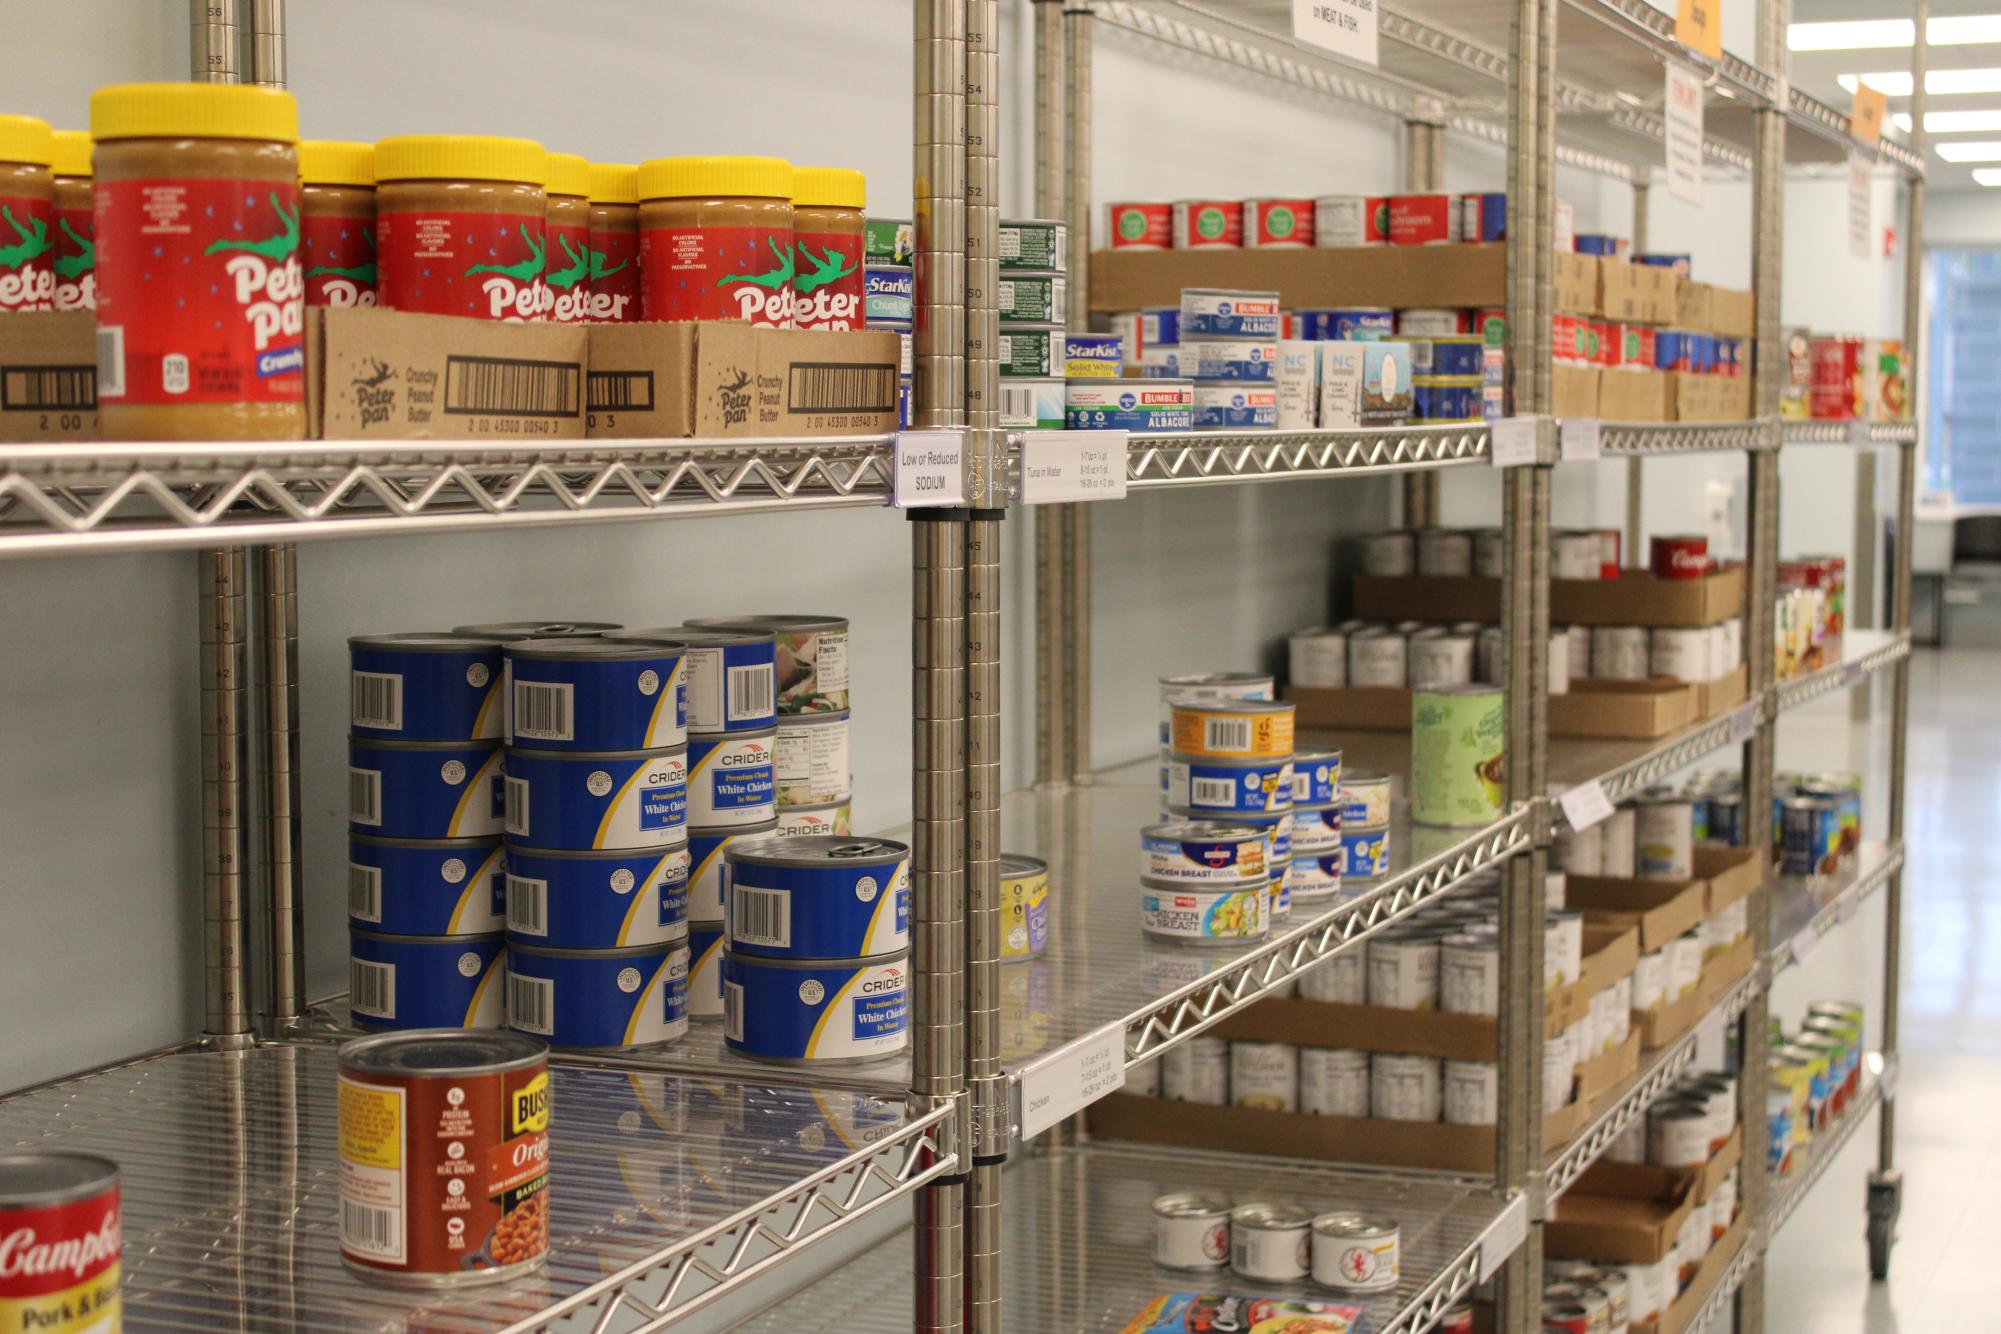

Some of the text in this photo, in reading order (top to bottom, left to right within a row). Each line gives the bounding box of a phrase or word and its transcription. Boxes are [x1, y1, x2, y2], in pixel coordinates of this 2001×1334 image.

[967, 34, 982, 43] 55
[967, 85, 982, 94] 54
[967, 136, 982, 145] 53
[967, 187, 982, 196] 52
[967, 238, 980, 247] 51
[967, 289, 982, 299] 50
[795, 288, 860, 323] eter
[967, 340, 982, 349] 49
[1067, 362, 1091, 372] Solid
[406, 367, 438, 387] Crunchy
[757, 374, 783, 391] Crunchy
[356, 386, 395, 407] Peter
[407, 387, 434, 404] Peanut
[721, 391, 752, 410] Peter
[759, 392, 781, 405] Peanut
[967, 391, 982, 400] 48
[1145, 393, 1177, 403] BUMBLE
[407, 407, 431, 423] Butter
[759, 409, 779, 423] Butter
[61, 415, 81, 430] 00
[468, 419, 474, 432] 2
[479, 419, 489, 433] 00
[553, 421, 559, 433] 3
[806, 415, 878, 429] 2 00 45300 00540 3
[902, 450, 959, 466] Low or Reduced
[1027, 465, 1062, 478] Tuna in Water
[916, 475, 946, 491] SODIUM
[818, 636, 844, 646] Nutrition
[818, 645, 837, 654] Facts
[721, 751, 769, 767] CRIDER
[725, 773, 752, 782] Premium
[717, 781, 772, 795] White Chicken
[745, 794, 762, 802] Water
[645, 803, 669, 815] White
[778, 824, 829, 837] CRIDER
[1151, 866, 1212, 878] CHICKEN BREAST
[1151, 911, 1199, 921] CHICKEN
[1157, 919, 1200, 931] BREAST
[866, 1001, 891, 1010] Premium
[858, 1013, 884, 1024] White
[877, 1024, 884, 1032] In
[1029, 1095, 1050, 1113] Chicken
[516, 1178, 541, 1200] BAKED
[22, 1303, 73, 1330] Pork
